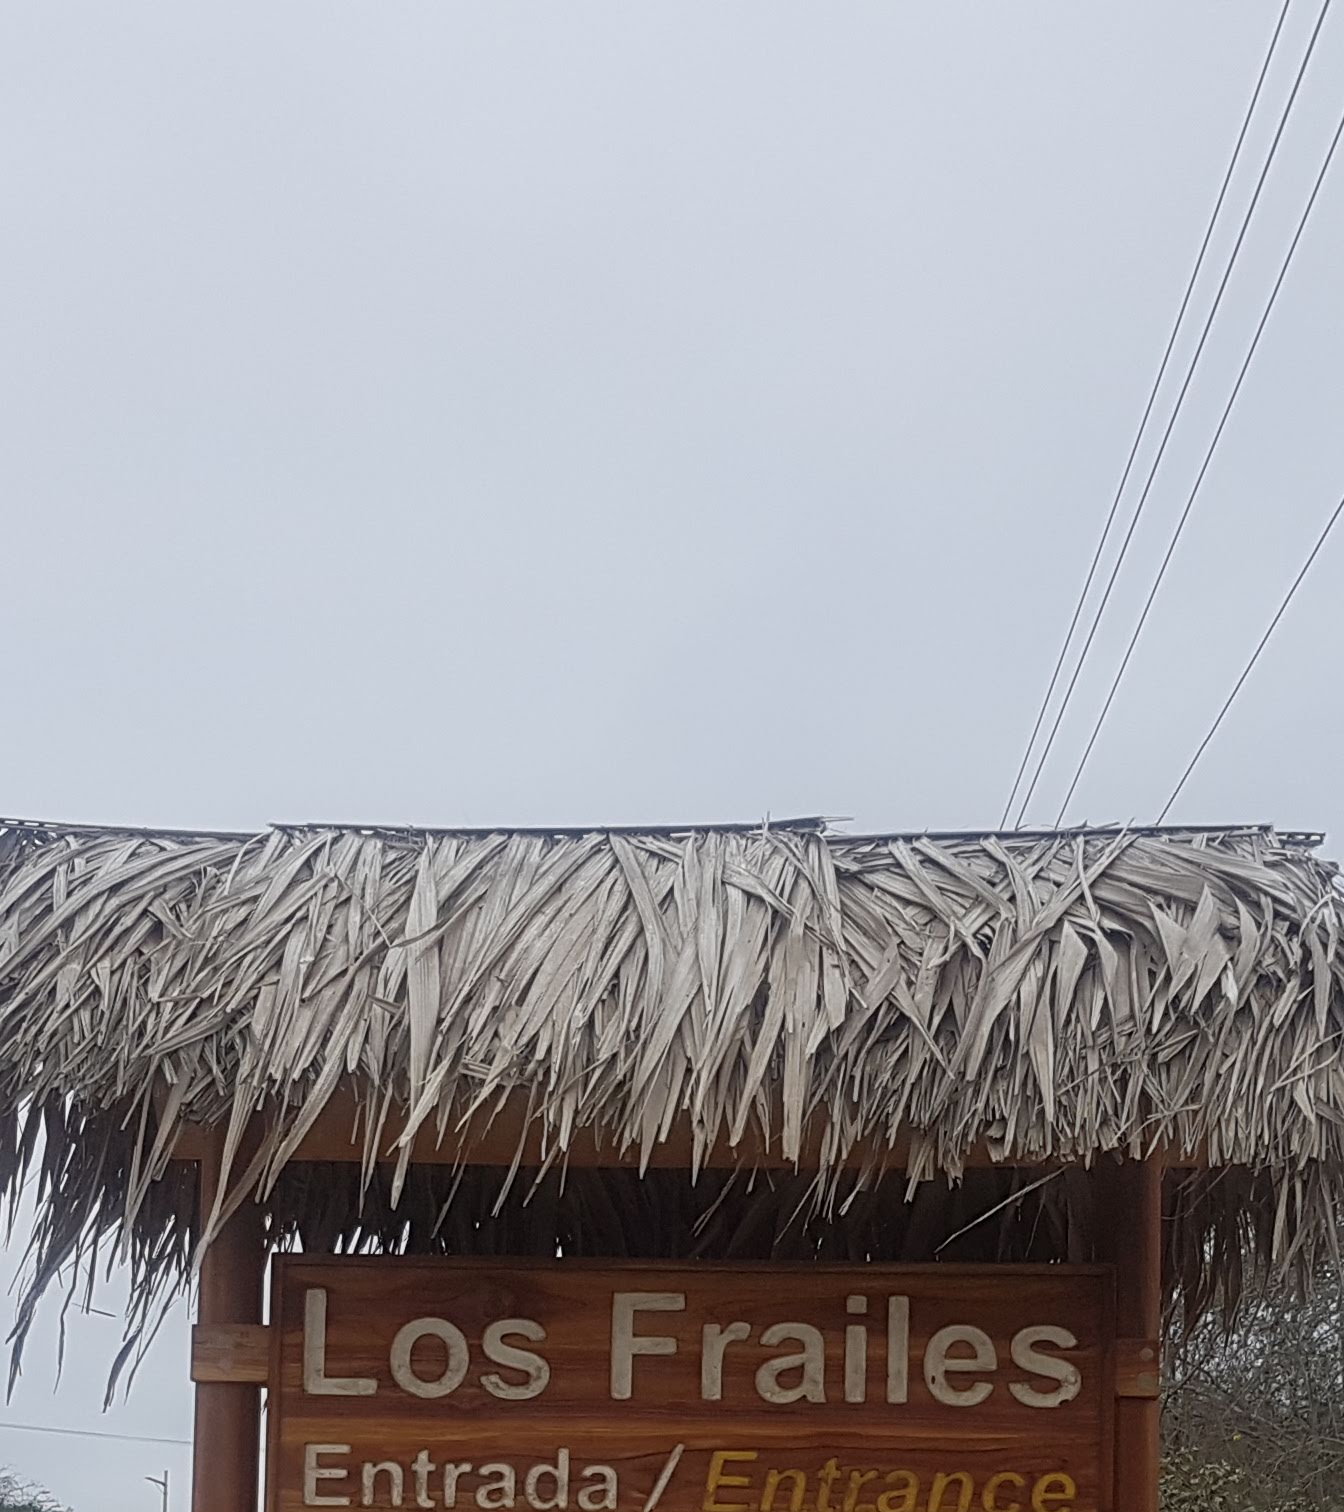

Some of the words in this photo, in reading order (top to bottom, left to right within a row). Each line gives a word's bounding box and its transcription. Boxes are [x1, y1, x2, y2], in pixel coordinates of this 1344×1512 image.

[302, 1287, 551, 1401] Los
[610, 1290, 1082, 1408] Frailes
[302, 1442, 618, 1512] Entrada
